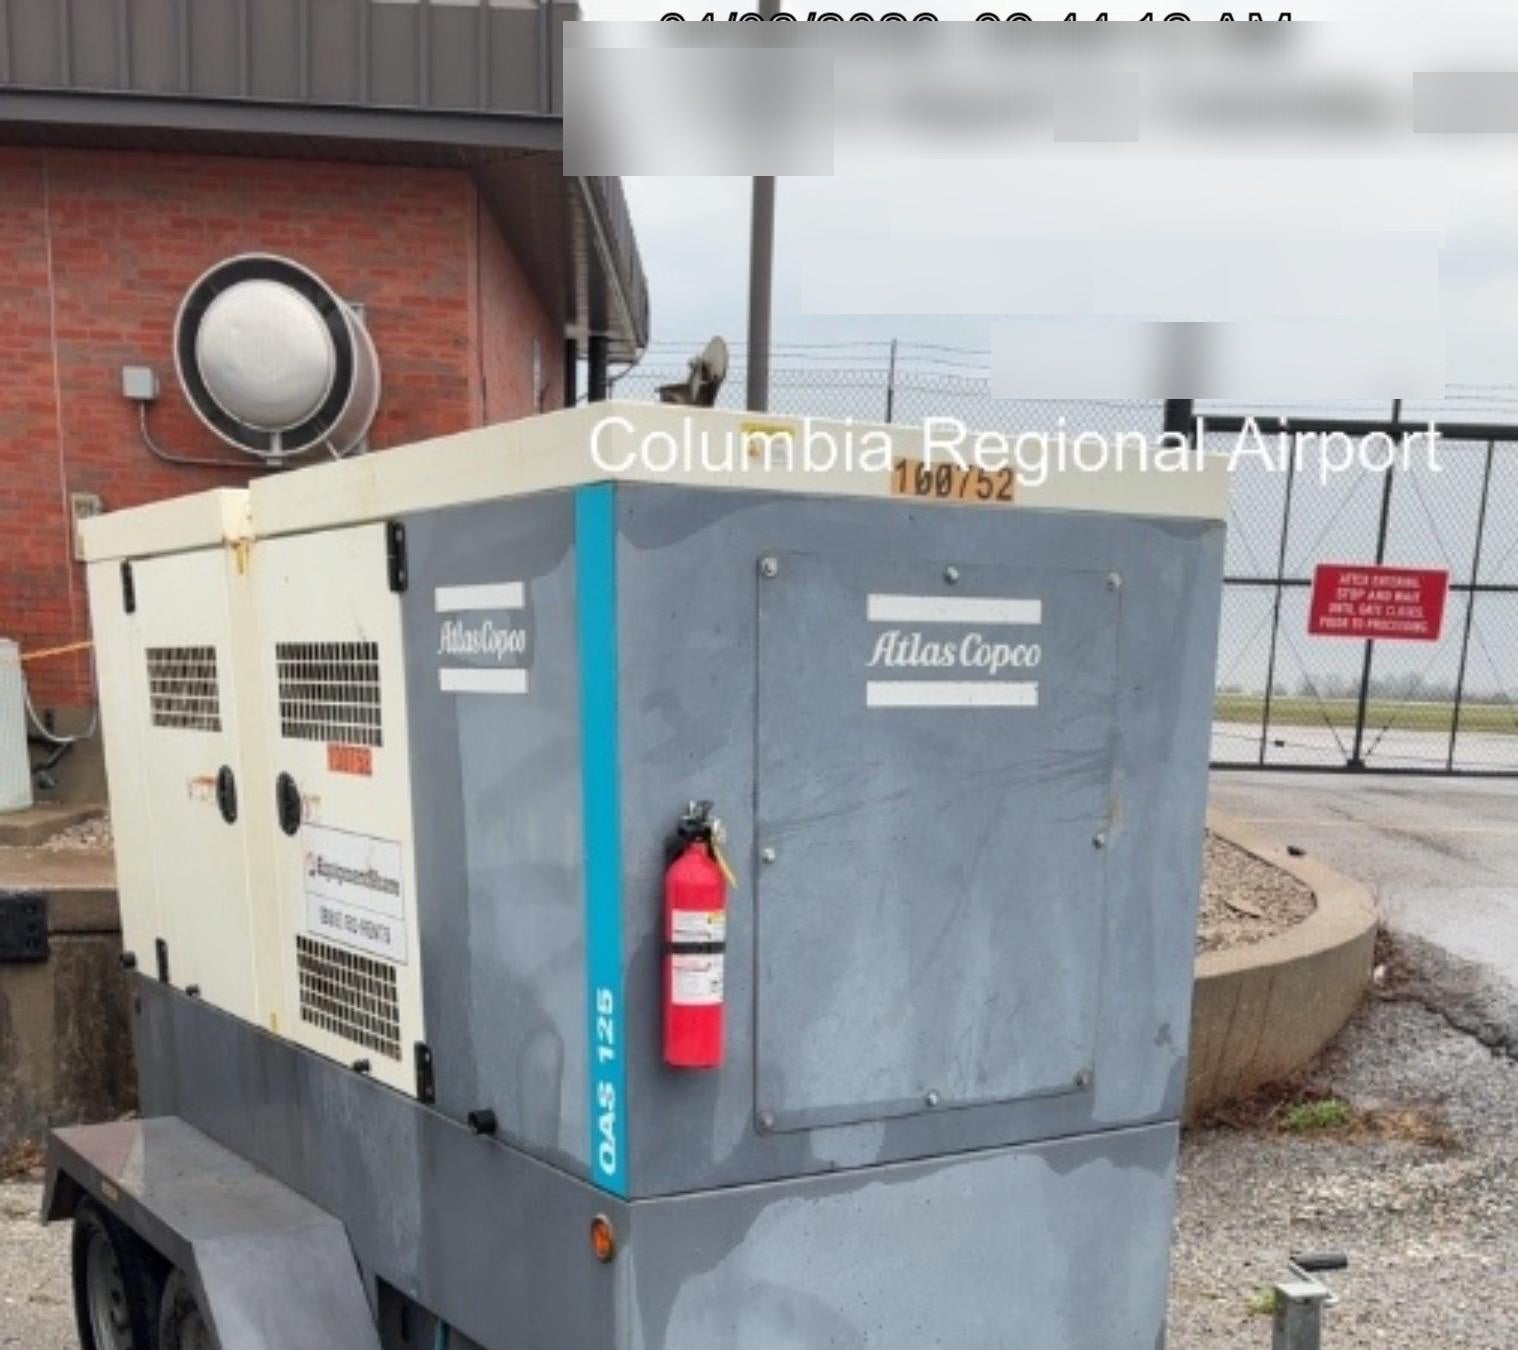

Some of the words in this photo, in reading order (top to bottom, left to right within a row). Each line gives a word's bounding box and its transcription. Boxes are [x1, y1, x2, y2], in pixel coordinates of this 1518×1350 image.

[1336, 587, 1366, 601] STOP
[1367, 590, 1393, 602] AND
[1394, 591, 1422, 604] WAIT
[1358, 604, 1383, 617] GATE
[1351, 618, 1364, 630] TO
[596, 986, 614, 1064] 125
